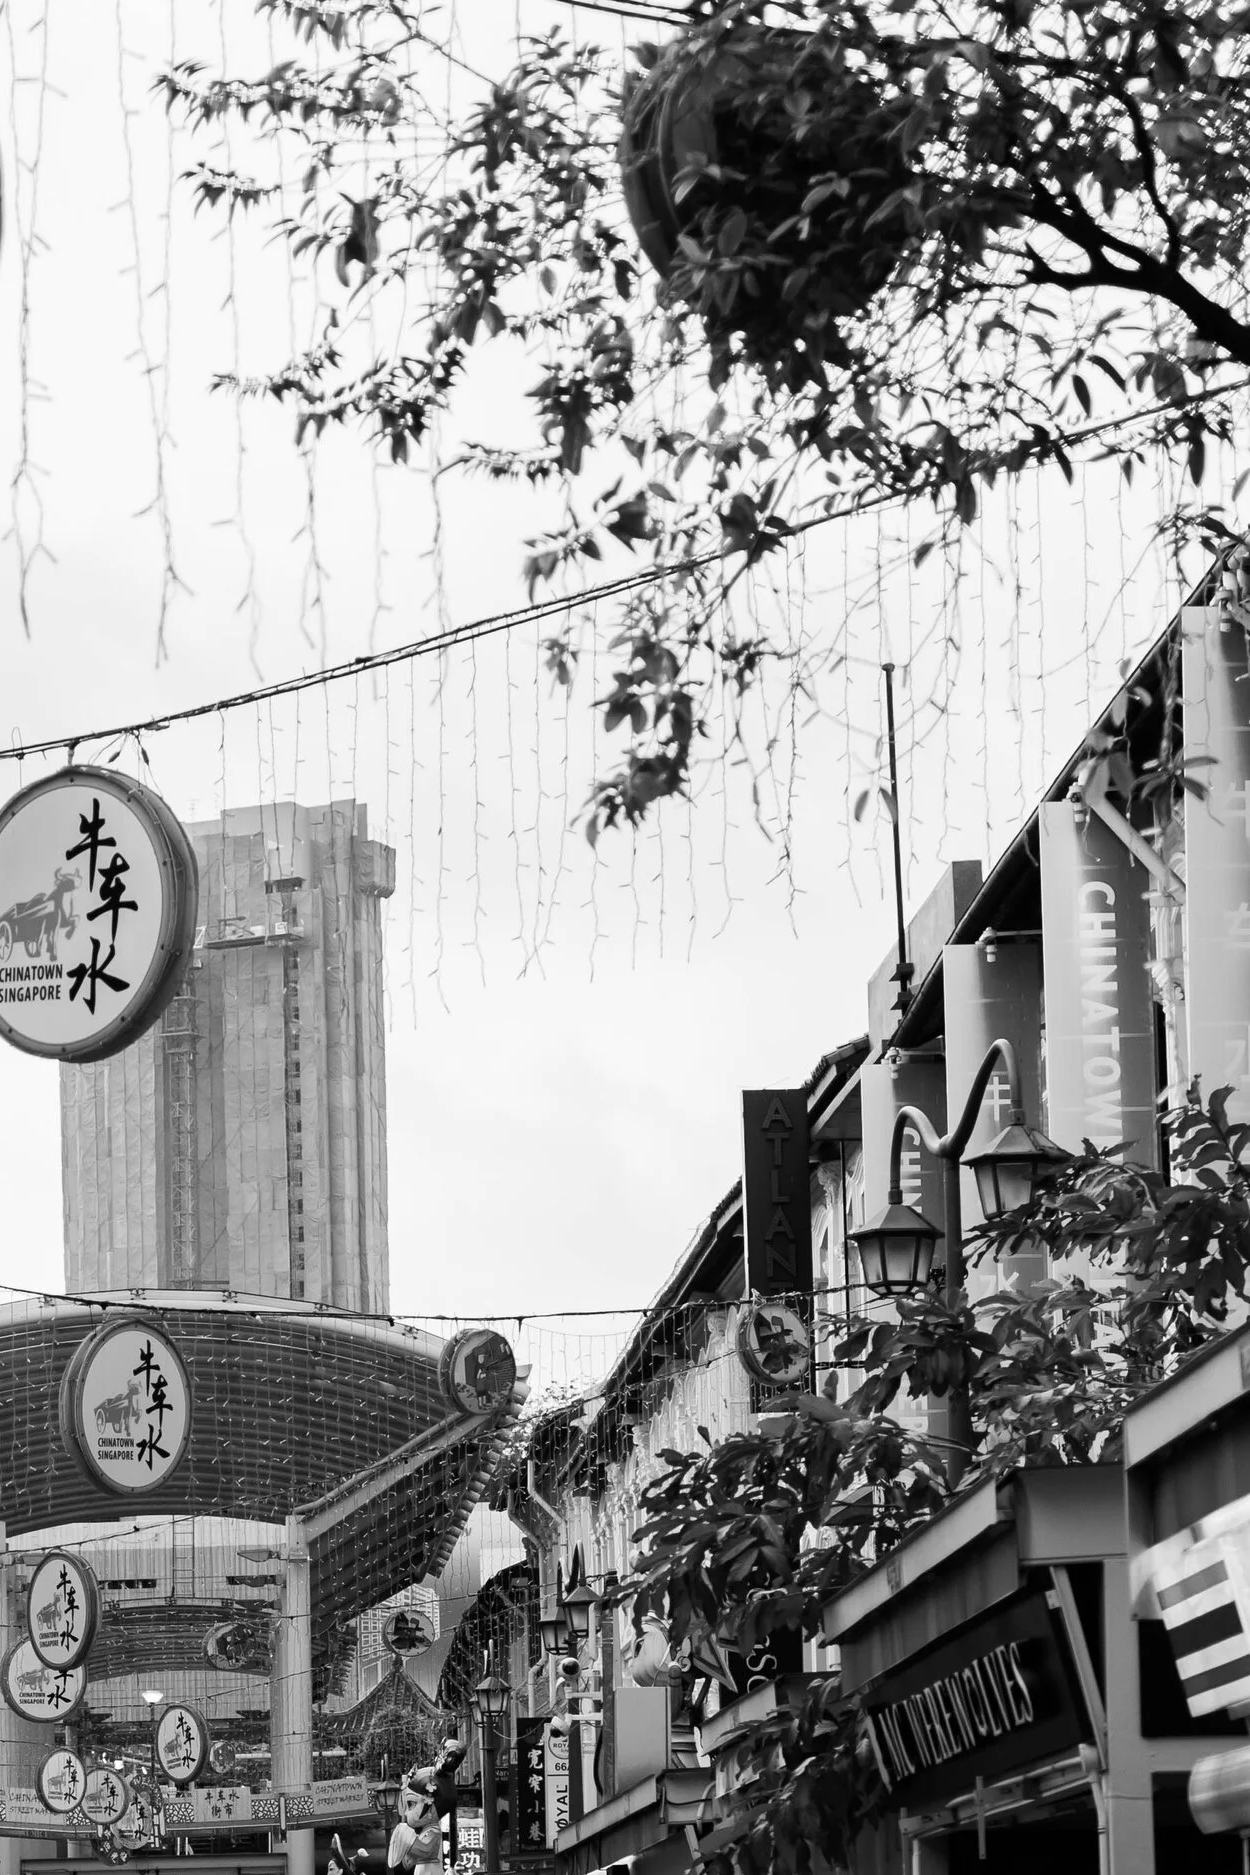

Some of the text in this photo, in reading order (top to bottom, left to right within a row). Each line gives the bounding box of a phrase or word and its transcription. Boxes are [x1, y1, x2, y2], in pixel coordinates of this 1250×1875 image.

[760, 1094, 798, 1288] ATLAN
[98, 1438, 134, 1448] CHINATOWN
[98, 1450, 134, 1461] SINGAPORE
[902, 1642, 1034, 1768] WEREWOLVES
